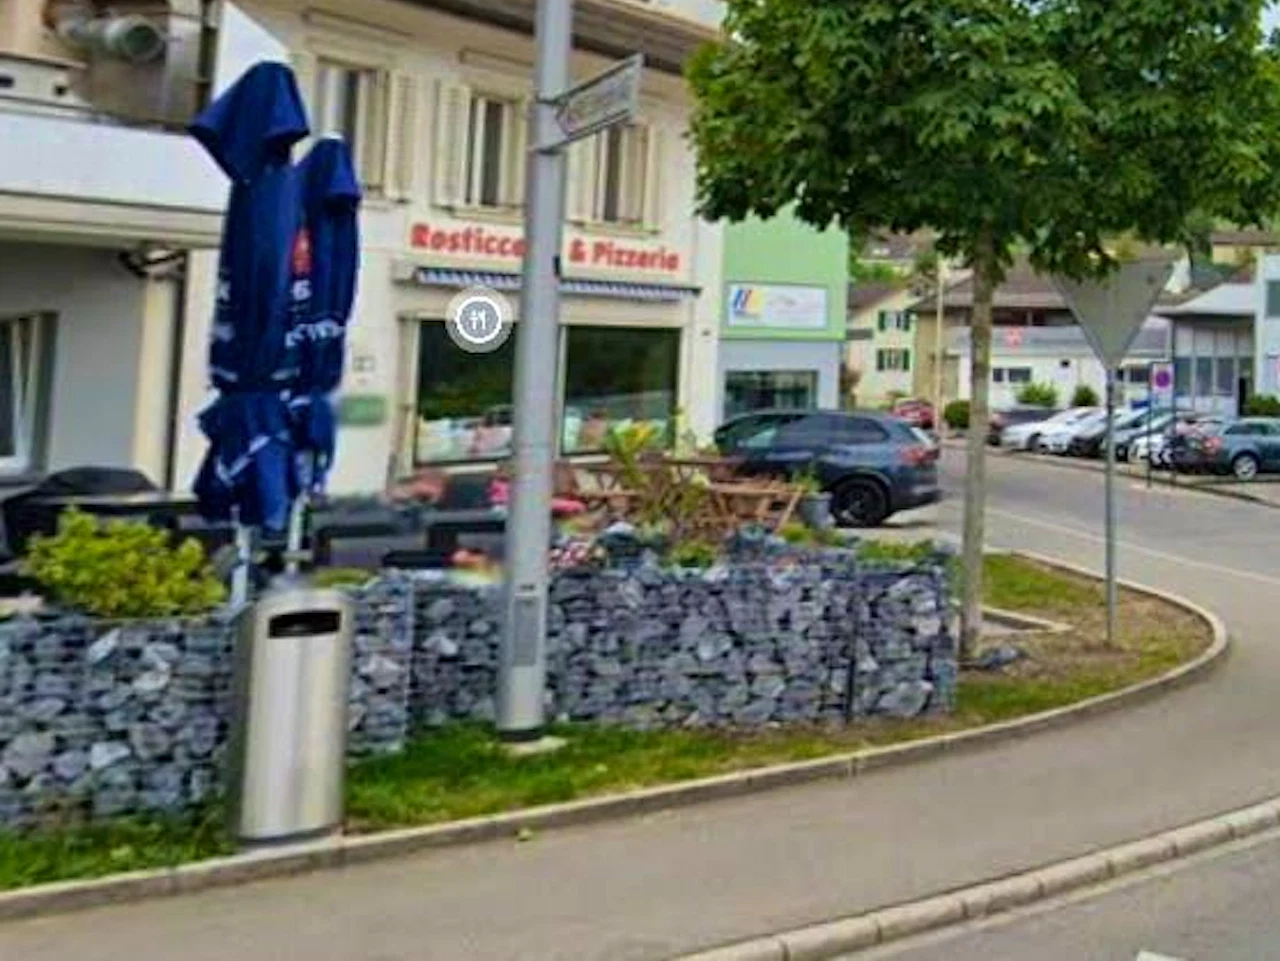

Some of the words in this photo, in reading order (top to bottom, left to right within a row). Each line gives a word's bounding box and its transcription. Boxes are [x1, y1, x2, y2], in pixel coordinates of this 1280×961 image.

[411, 223, 528, 257] Rosticce
[569, 238, 586, 262] &
[592, 240, 680, 271] Pizzeria
